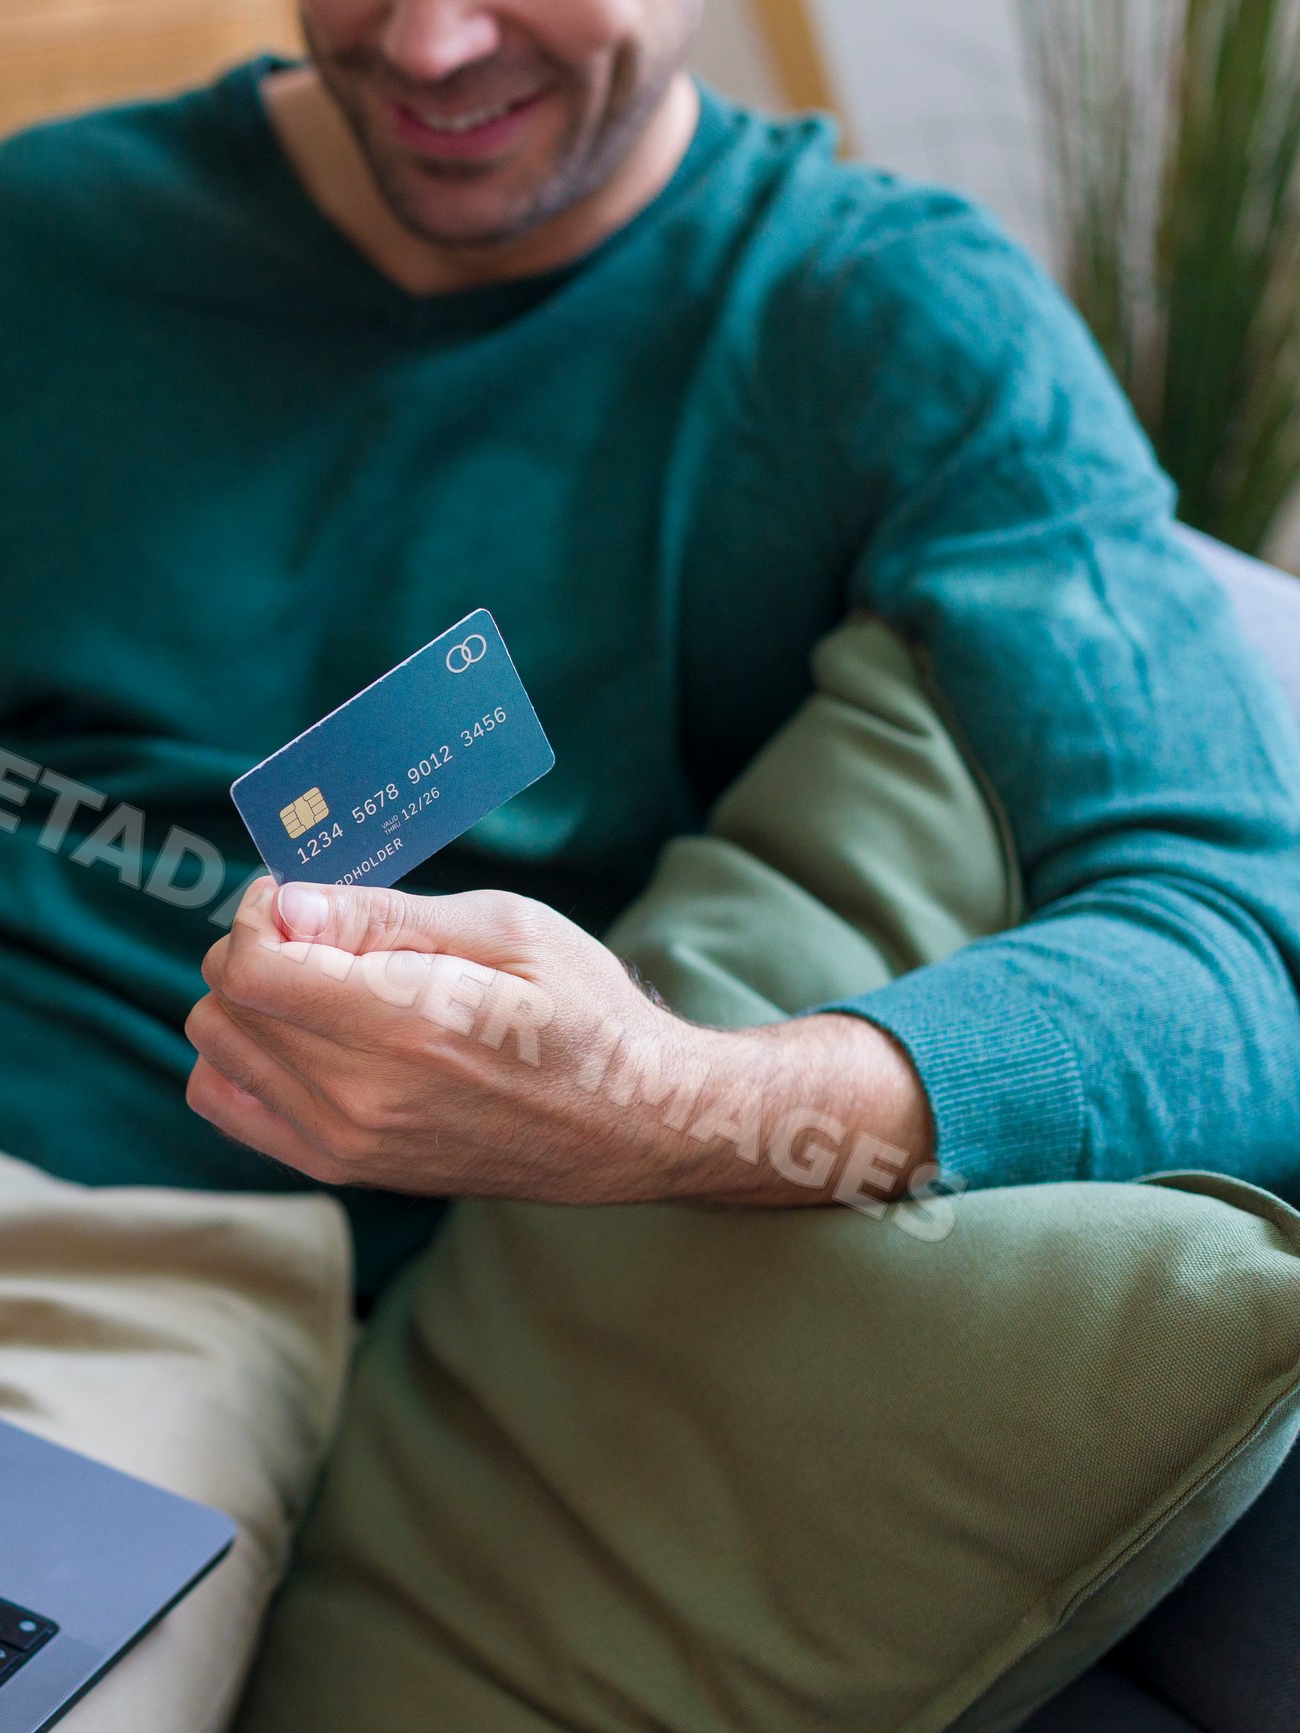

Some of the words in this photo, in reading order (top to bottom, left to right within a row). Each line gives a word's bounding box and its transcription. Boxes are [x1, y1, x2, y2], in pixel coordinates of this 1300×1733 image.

[297, 822, 343, 865] 1234
[351, 783, 399, 825] 5678
[407, 745, 453, 785] 9012
[460, 706, 507, 747] 3456
[401, 787, 440, 821] 12/26
[381, 814, 399, 830] VALID
[384, 822, 401, 836] THRU
